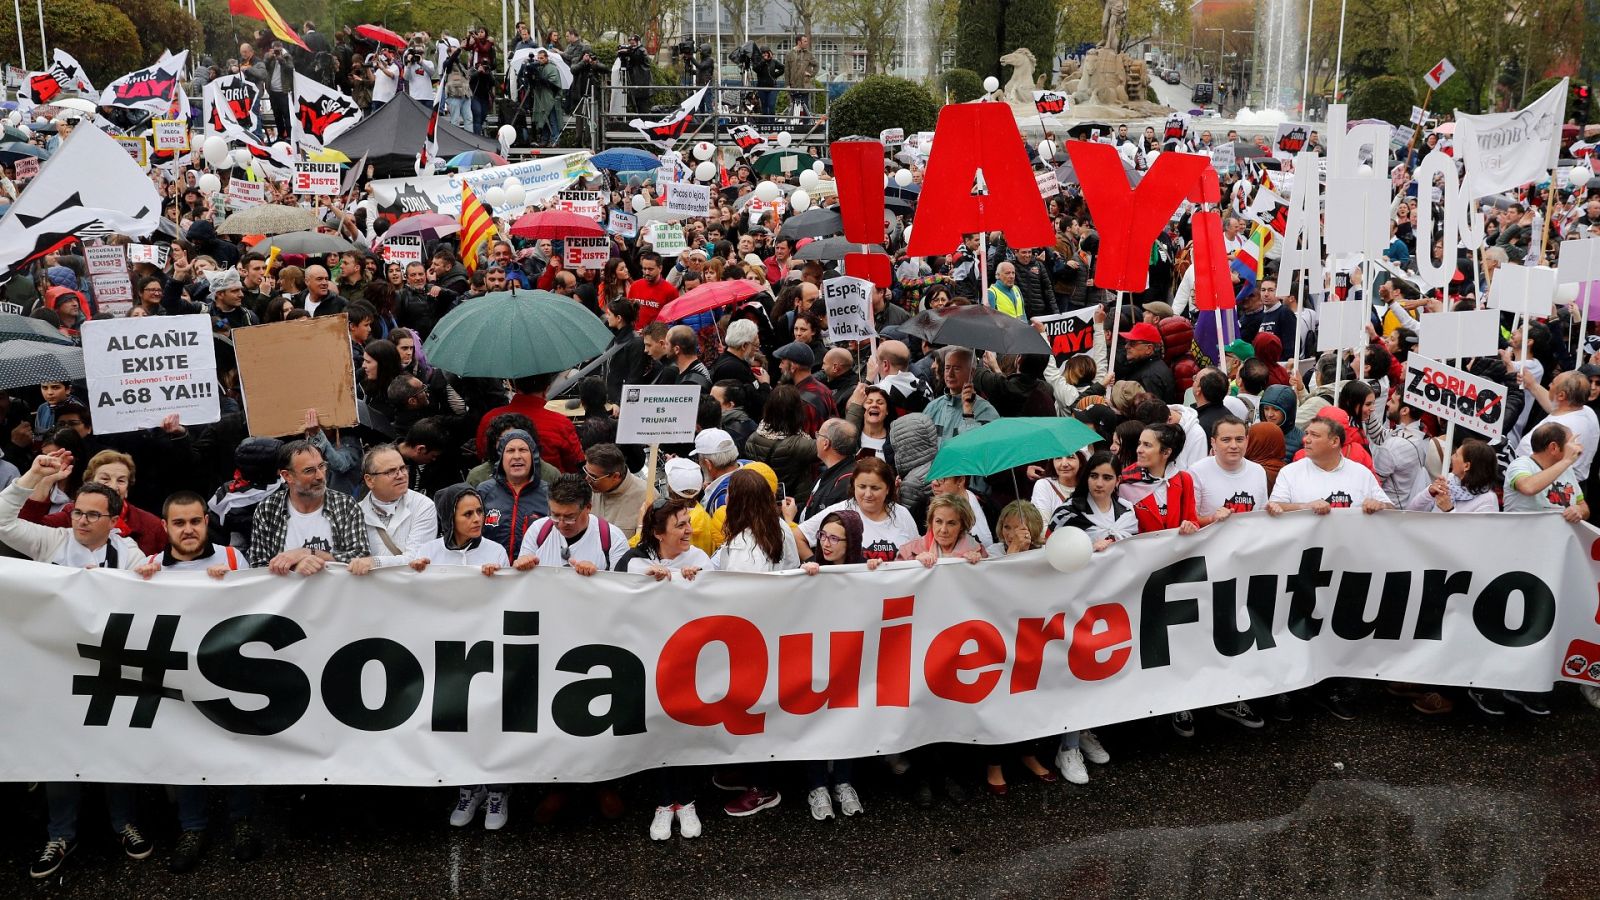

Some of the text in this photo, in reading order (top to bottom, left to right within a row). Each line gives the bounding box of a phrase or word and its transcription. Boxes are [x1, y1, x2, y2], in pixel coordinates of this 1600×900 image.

[296, 163, 339, 173] TERUEL
[401, 195, 431, 213] SORIA
[565, 237, 609, 247] TERUEL
[832, 321, 852, 335] vida
[107, 330, 199, 352] ALCAÑIZ
[122, 354, 189, 373] EXISTE
[1423, 367, 1479, 402] SORIA
[97, 382, 212, 408] A-68 YA!!!
[643, 396, 694, 404] PERMANECER
[1234, 496, 1253, 504] SORIA
[1331, 495, 1349, 504] SORIA
[873, 544, 894, 552] SORIA
[72, 547, 1557, 737] #SoriaQuiereFuturo
